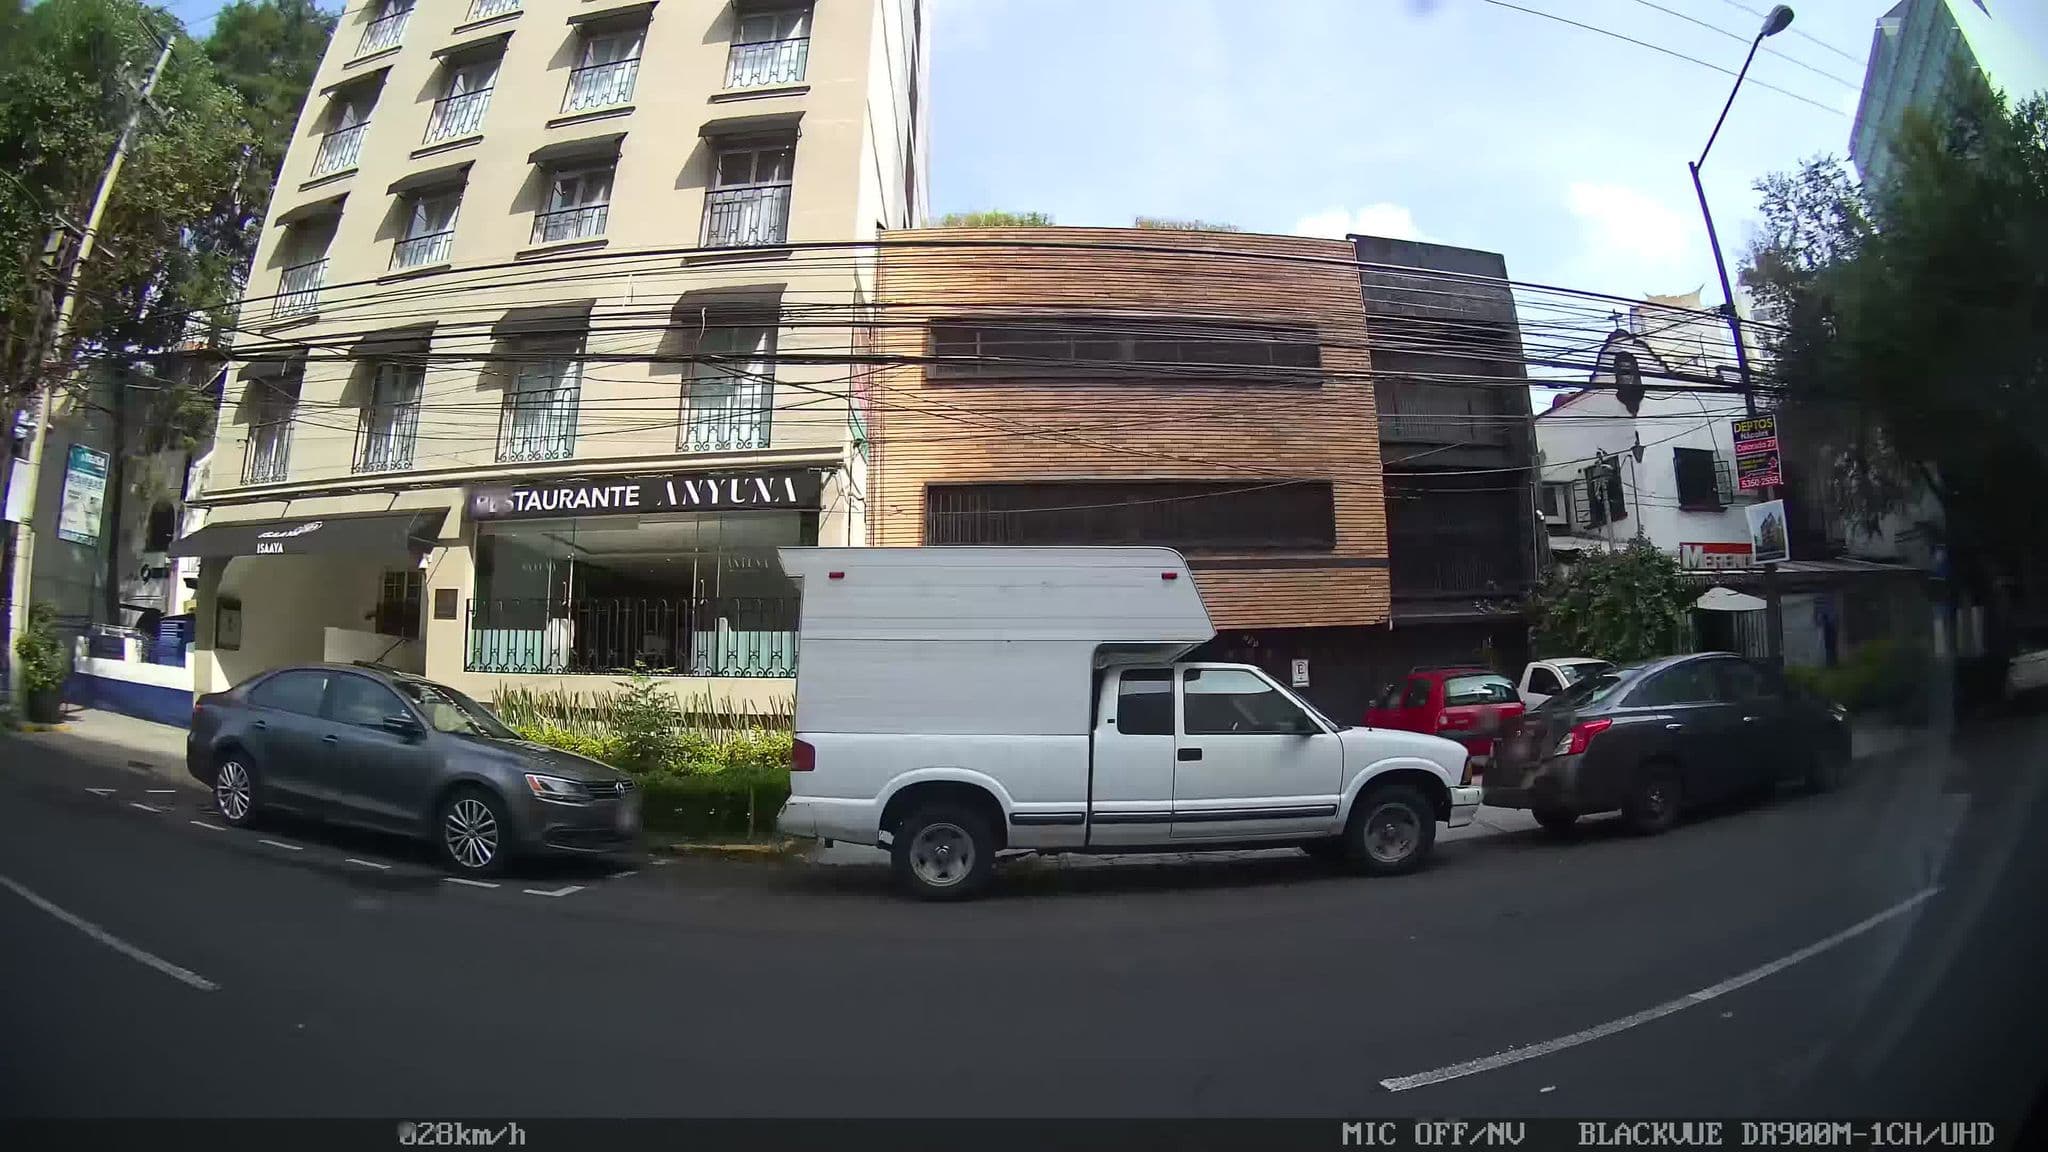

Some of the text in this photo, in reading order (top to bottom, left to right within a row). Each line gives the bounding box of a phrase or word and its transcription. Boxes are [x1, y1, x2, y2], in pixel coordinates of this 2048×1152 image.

[1734, 418, 1773, 433] DEPTOS
[656, 477, 797, 506] ANYUNA
[256, 542, 284, 554] ISAAYA
[1298, 664, 1305, 674] E
